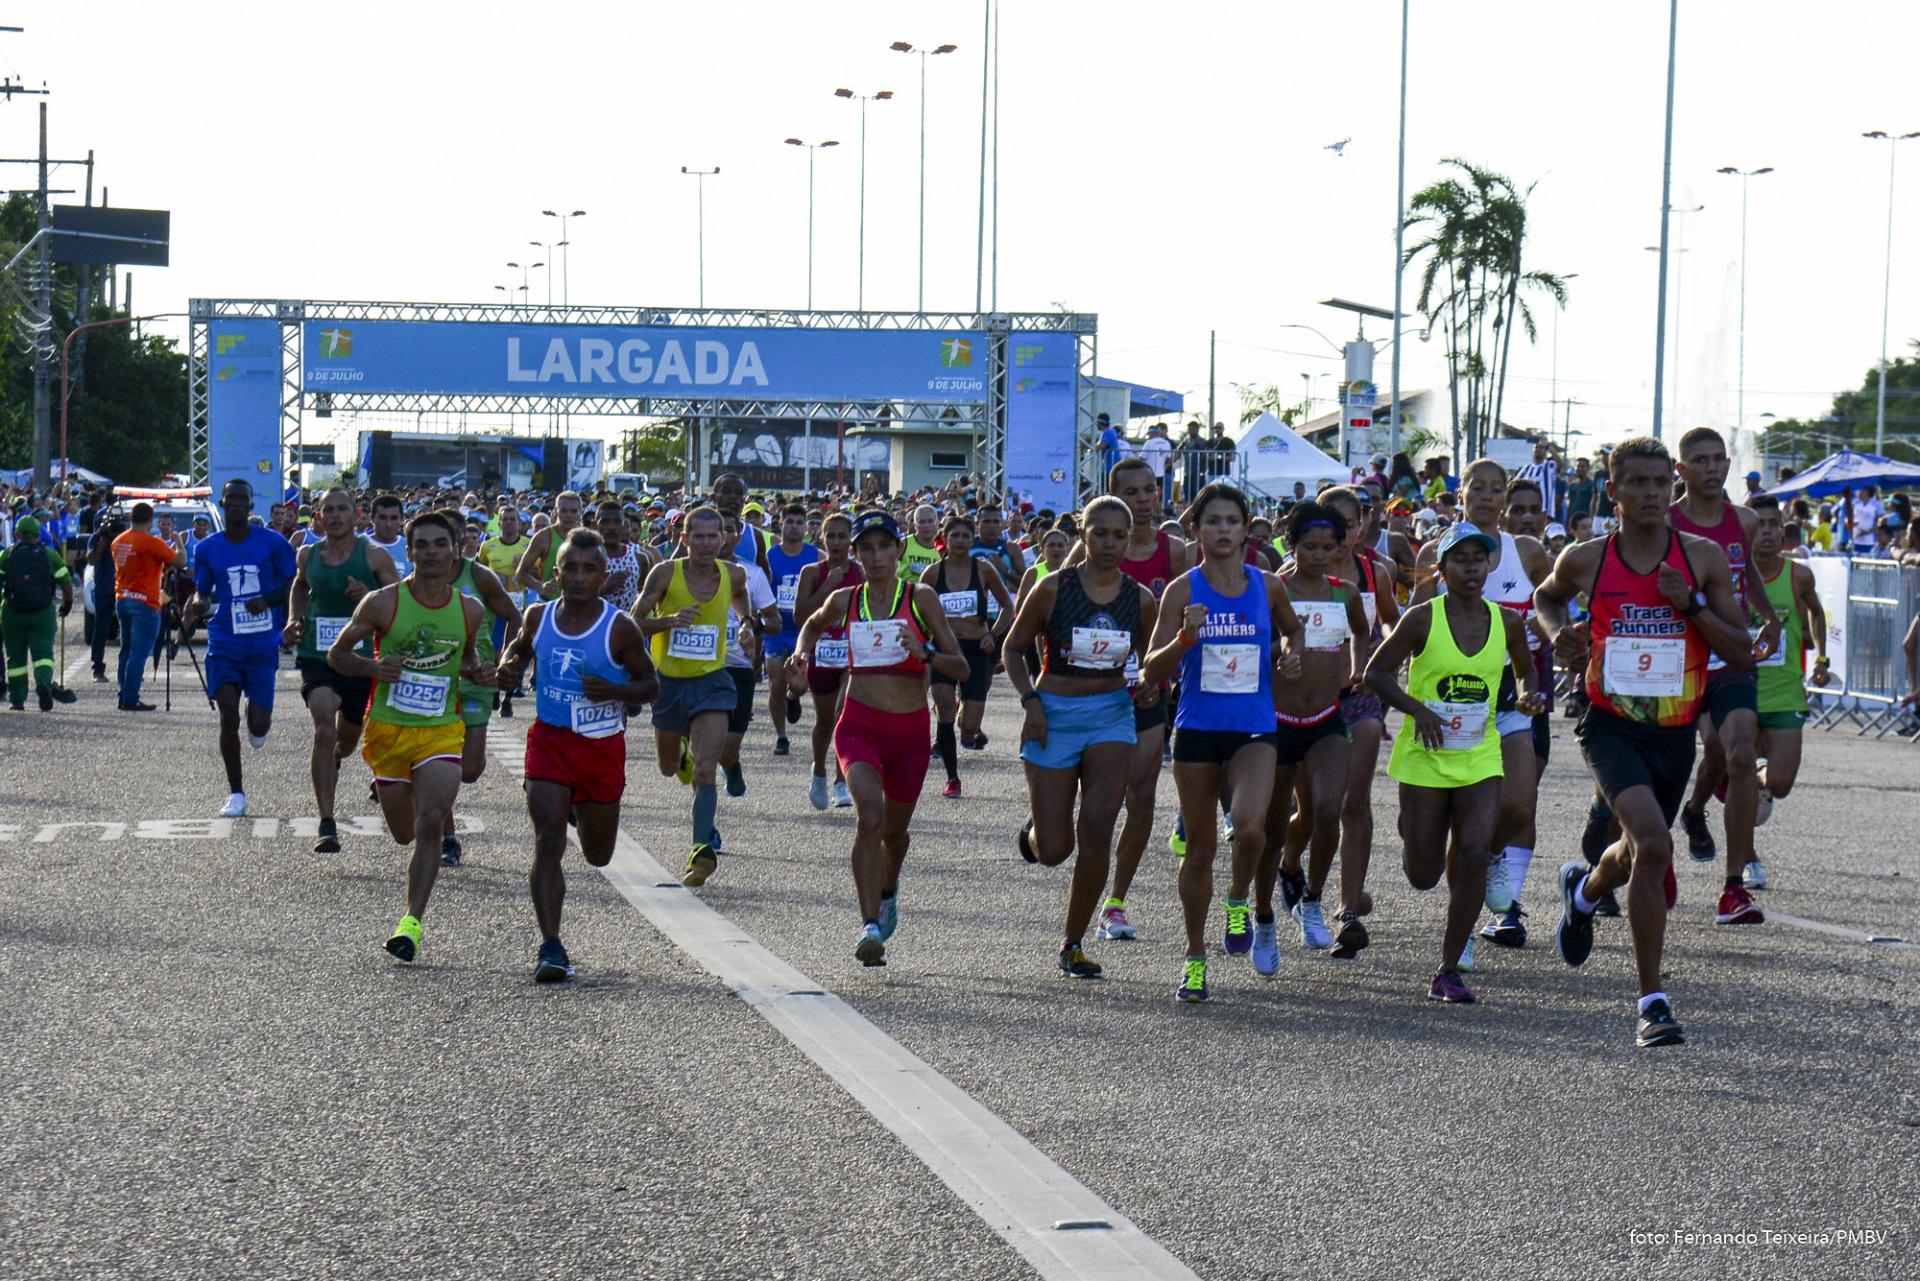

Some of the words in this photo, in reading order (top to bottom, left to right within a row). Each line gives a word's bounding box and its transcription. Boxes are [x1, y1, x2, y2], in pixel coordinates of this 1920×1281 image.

[506, 337, 769, 387] LARGADA
[307, 372, 314, 381] 9
[315, 372, 329, 381] DE
[330, 371, 364, 382] JULHO
[927, 380, 935, 390] 9
[935, 380, 949, 390] DE
[950, 380, 983, 391] JULHO
[943, 598, 973, 611] 10132
[1621, 603, 1673, 621] Traca
[1204, 612, 1237, 625] LITE
[1312, 612, 1323, 627] 8
[320, 626, 342, 639] 105
[1198, 623, 1257, 639] RUNNERS
[1610, 618, 1687, 637] Runners
[675, 632, 713, 647] 10518
[872, 631, 884, 647] 2
[818, 646, 849, 658] 1047
[1091, 640, 1111, 655] 17
[1225, 656, 1239, 673] 4
[1637, 652, 1653, 673] 9
[395, 681, 443, 702] 10254
[549, 690, 562, 701] DE
[1450, 714, 1463, 731] 6
